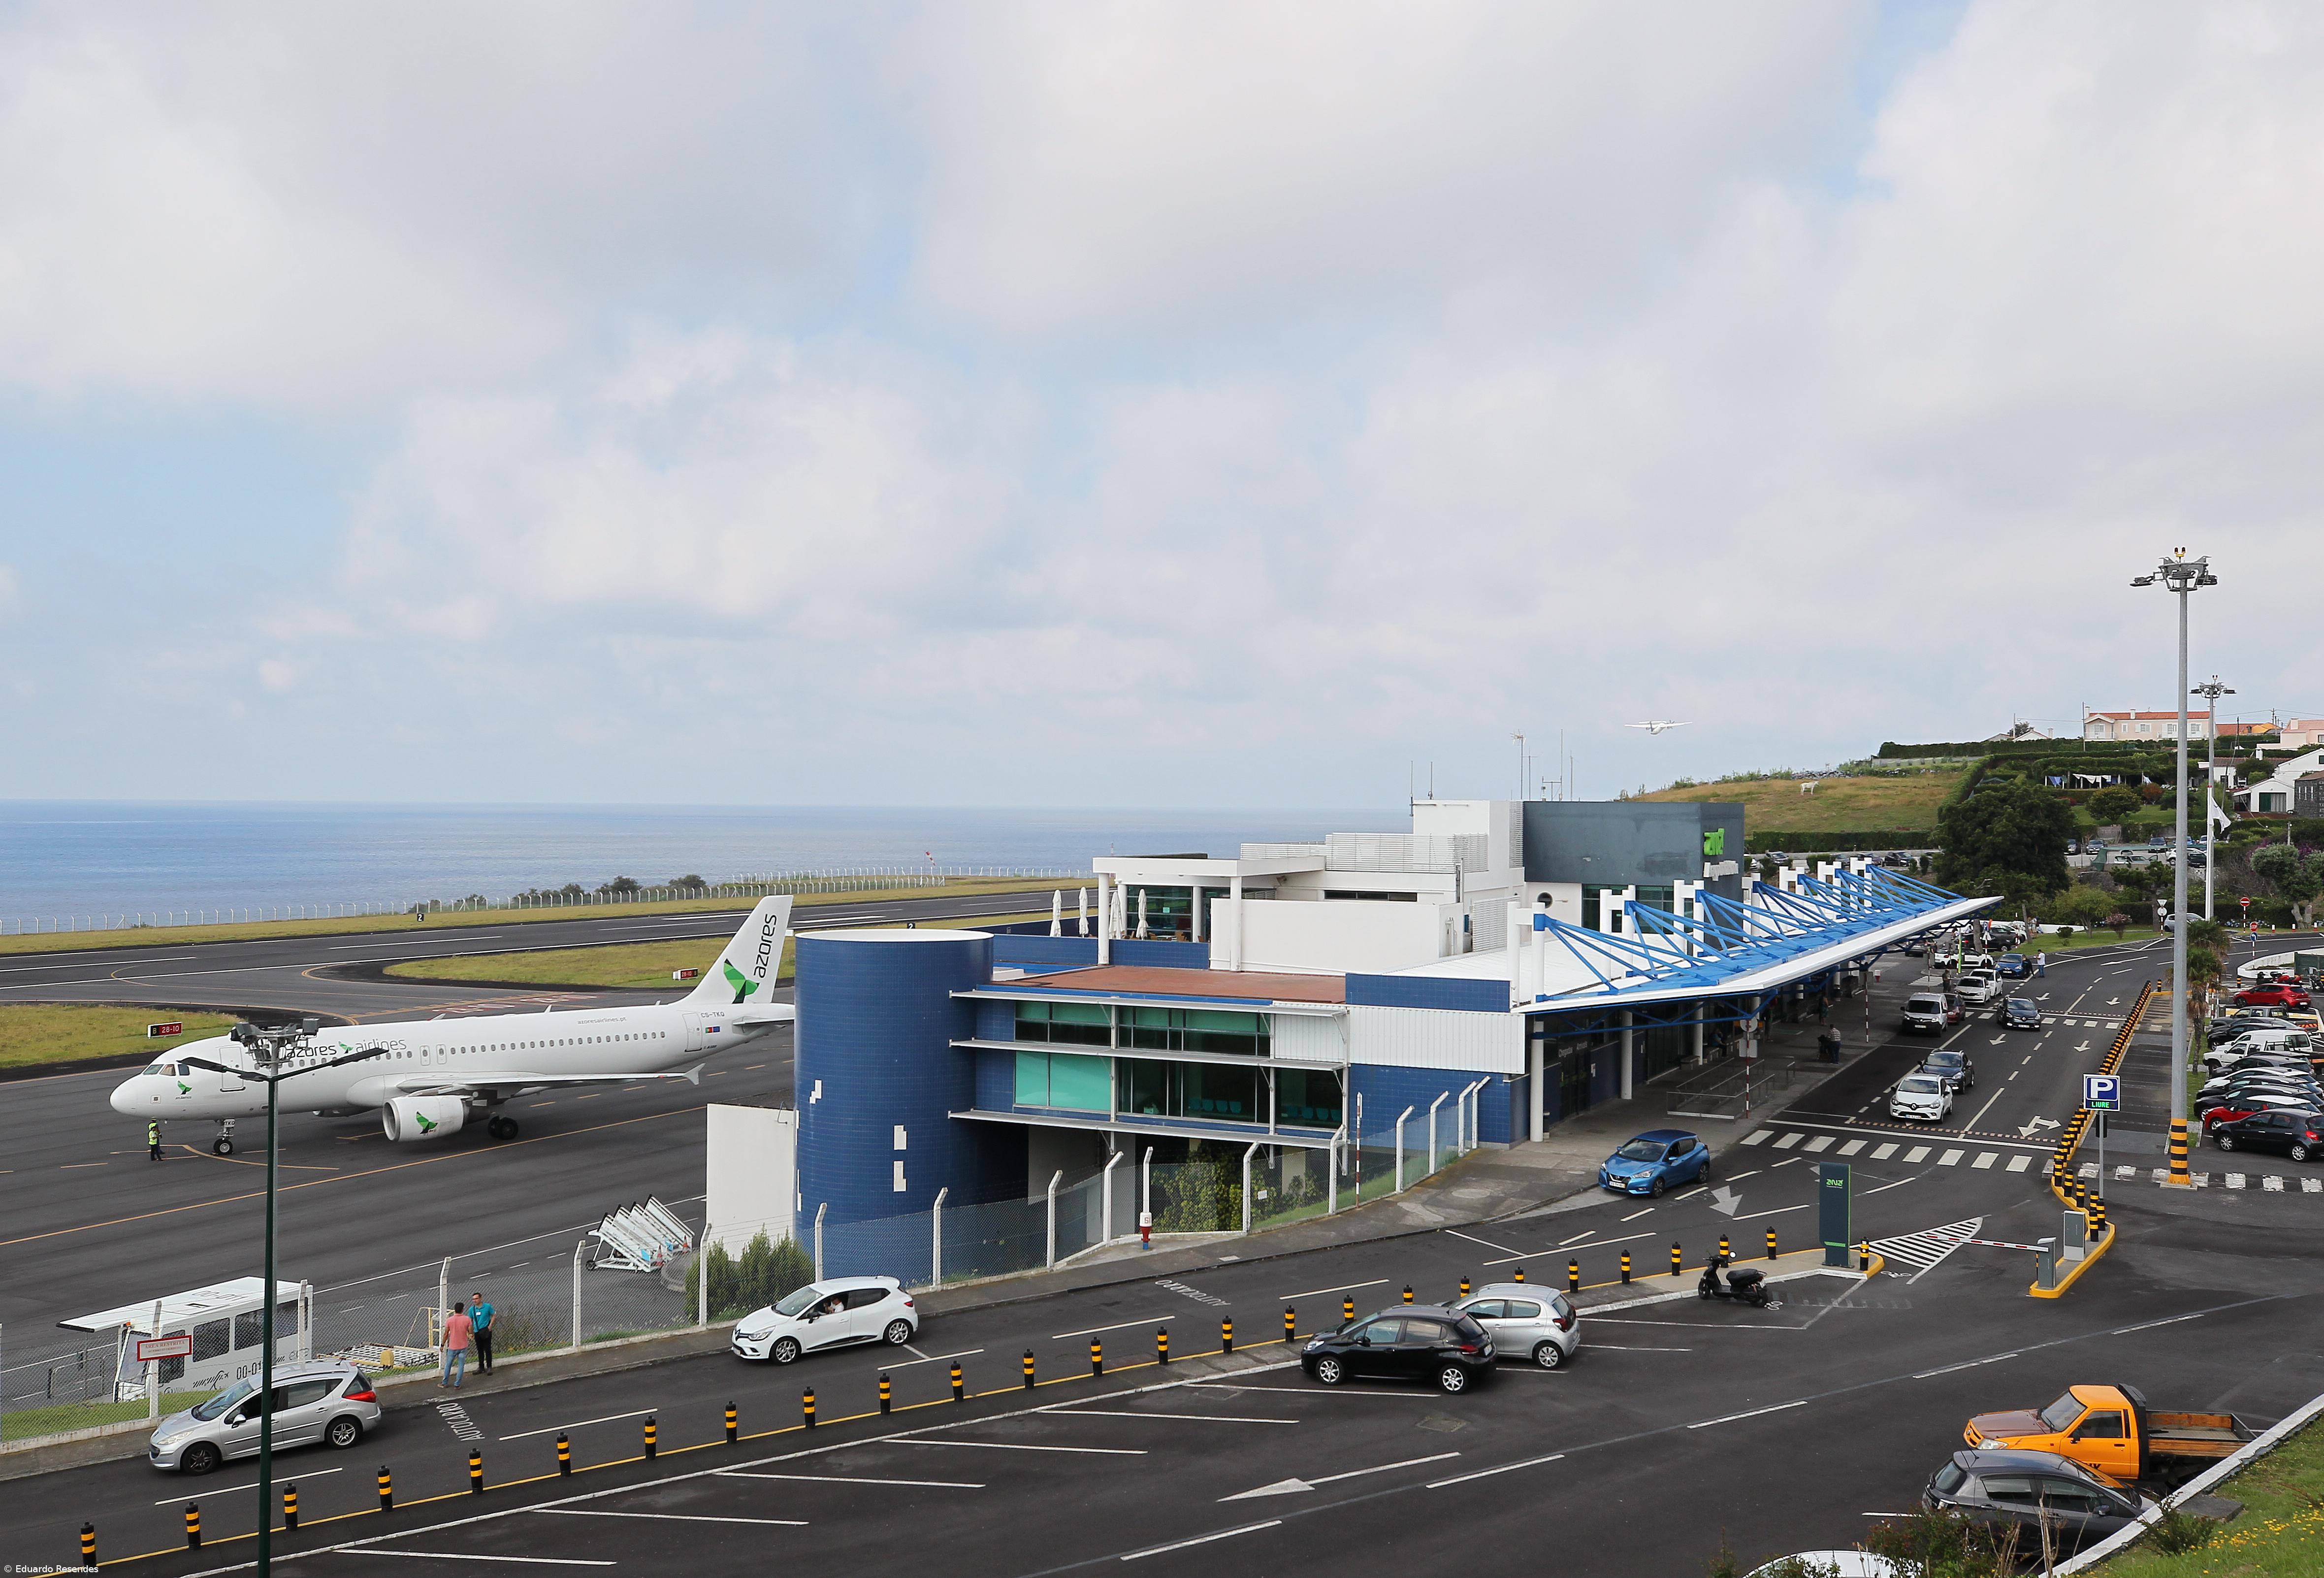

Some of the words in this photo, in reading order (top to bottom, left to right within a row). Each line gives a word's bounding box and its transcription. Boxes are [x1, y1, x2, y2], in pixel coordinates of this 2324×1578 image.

[753, 914, 776, 978] azores
[355, 1038, 407, 1053] airlines
[2090, 1078, 2114, 1099] P
[1155, 1280, 1231, 1307] AUTOCARRO
[436, 1403, 485, 1441] AUTOCARRO
